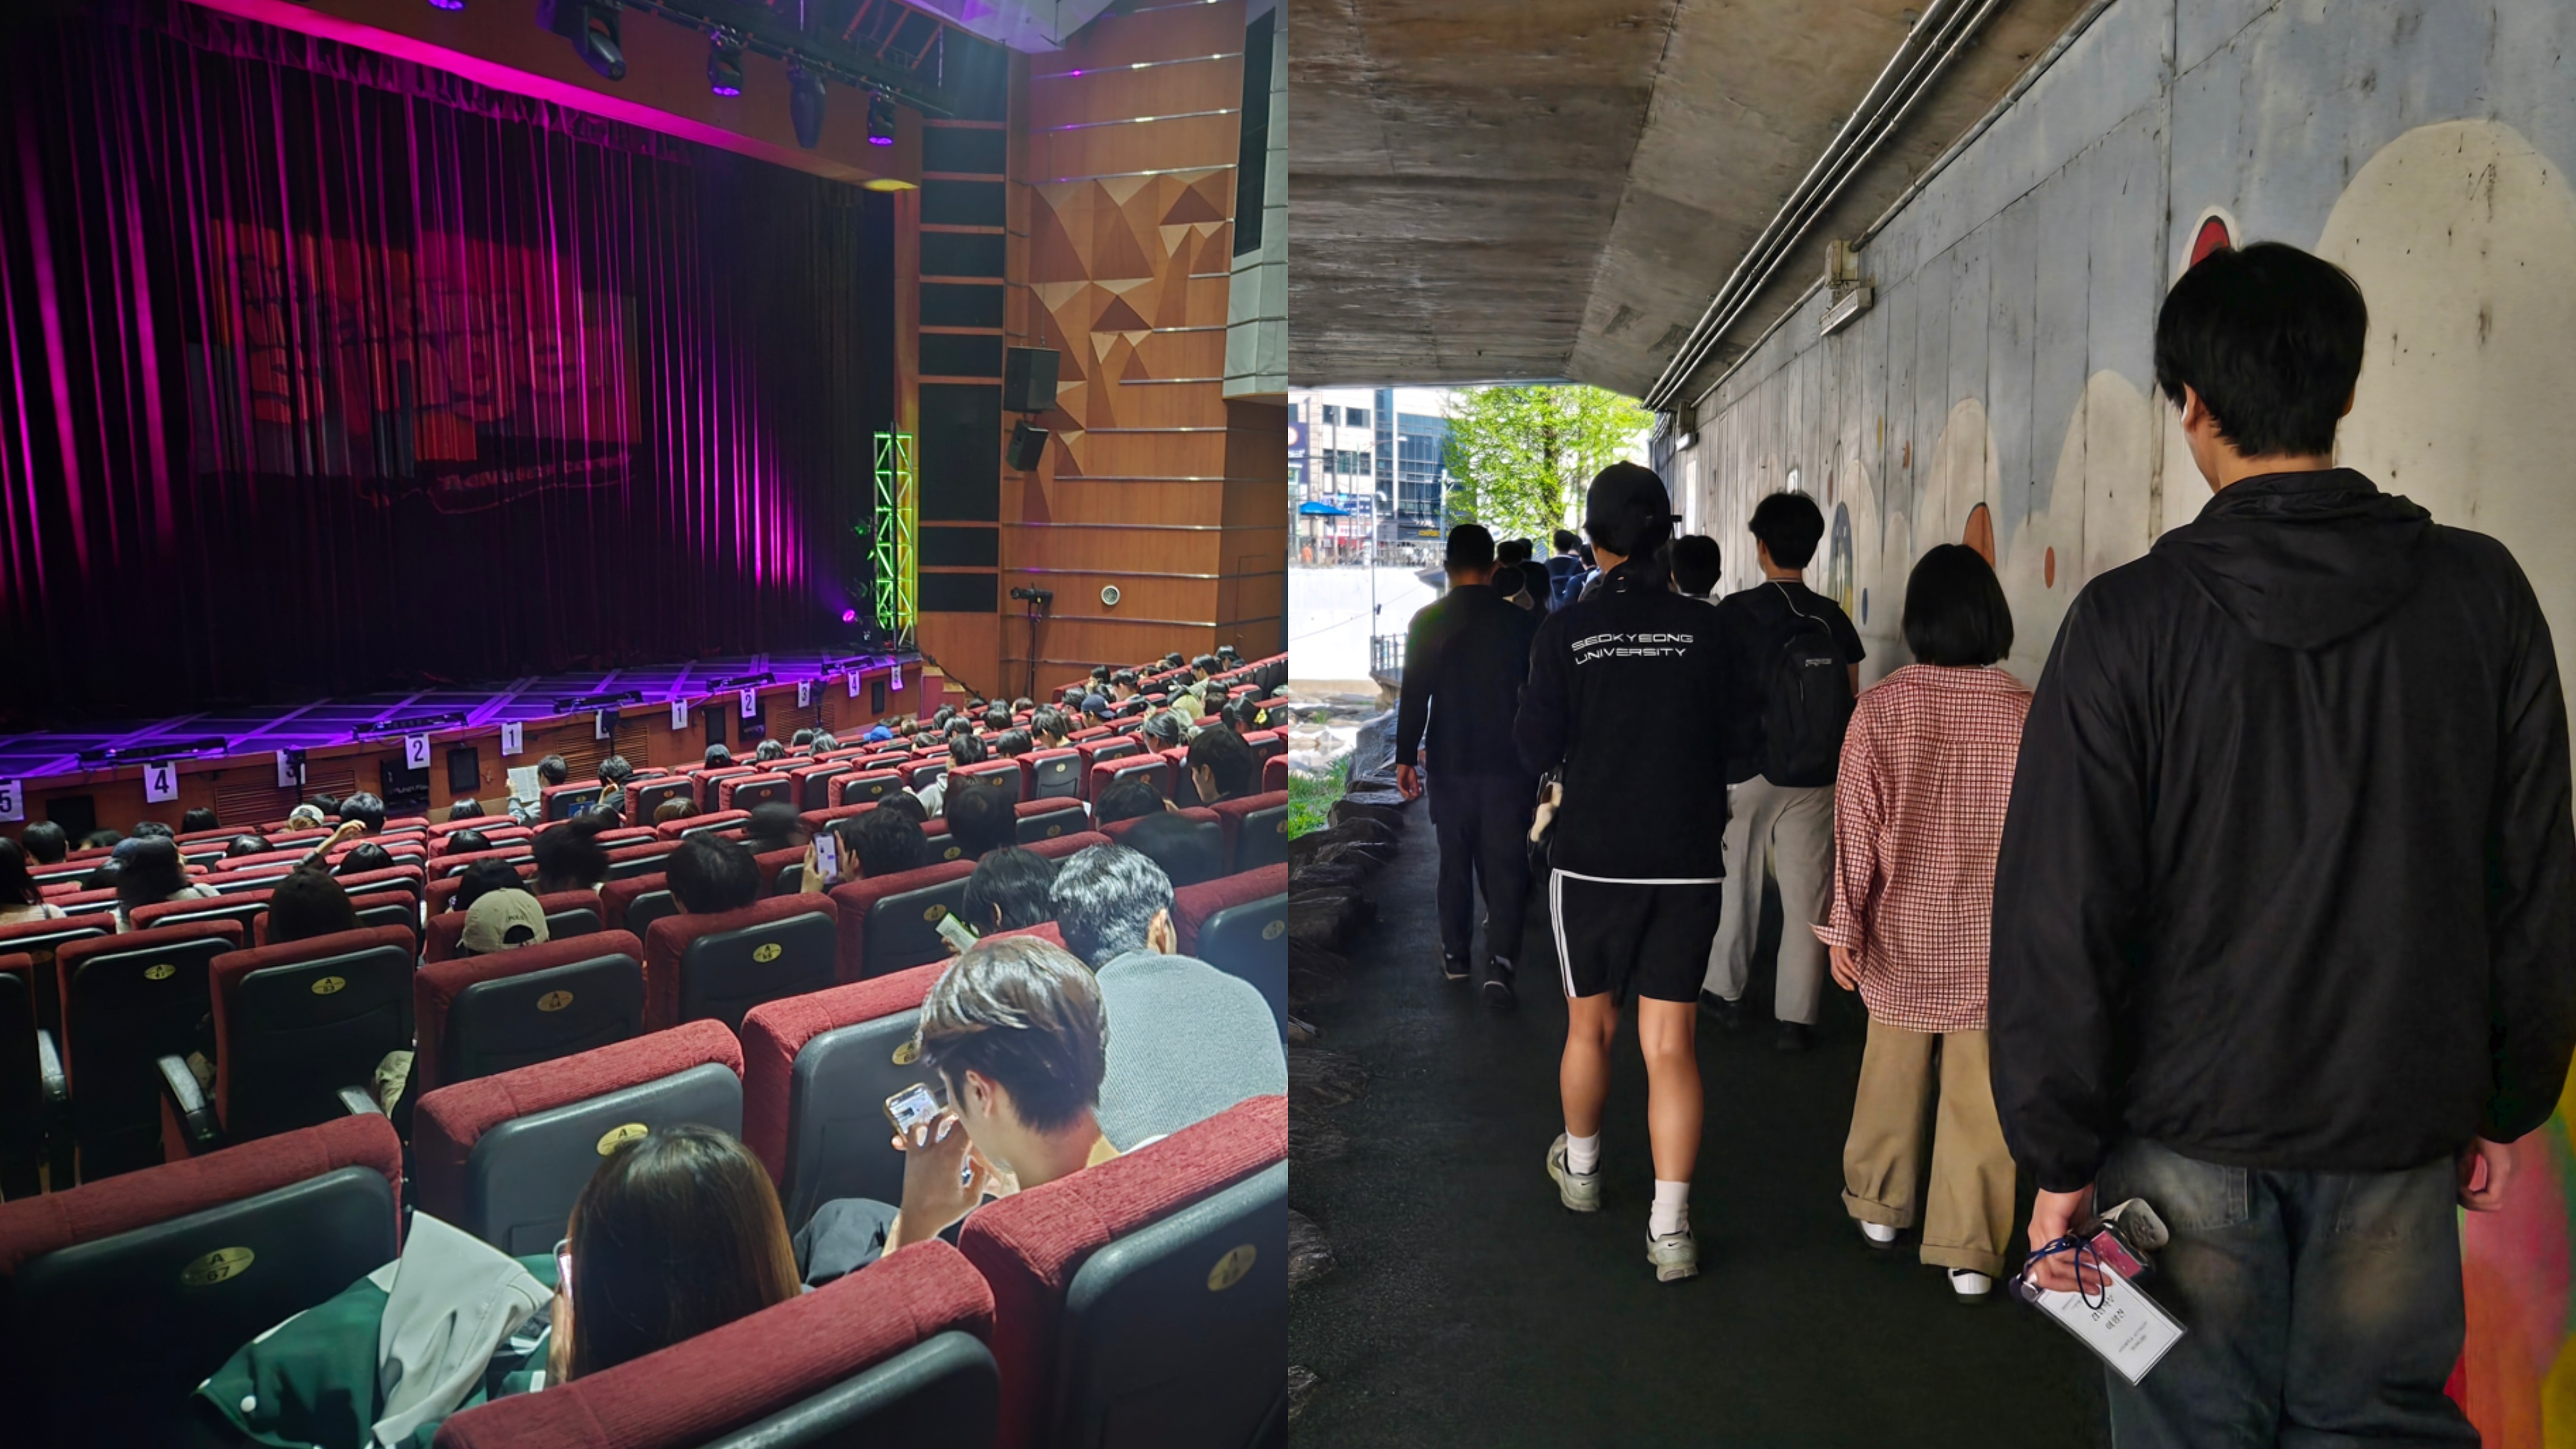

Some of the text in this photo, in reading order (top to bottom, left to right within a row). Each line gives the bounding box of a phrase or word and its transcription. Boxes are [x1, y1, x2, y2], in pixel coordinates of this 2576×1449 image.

[1571, 633, 1694, 652] SEOKYEONG
[1575, 647, 1687, 665] UNIVERSITY
[745, 694, 753, 711] 2
[801, 687, 807, 701] 3
[677, 706, 682, 723] 1
[508, 729, 514, 747] 1
[413, 740, 425, 762] 2
[154, 769, 170, 794] 4
[0, 789, 12, 813] 5
[618, 1128, 628, 1140] A
[211, 1253, 225, 1265] A
[206, 1265, 230, 1282] 67
